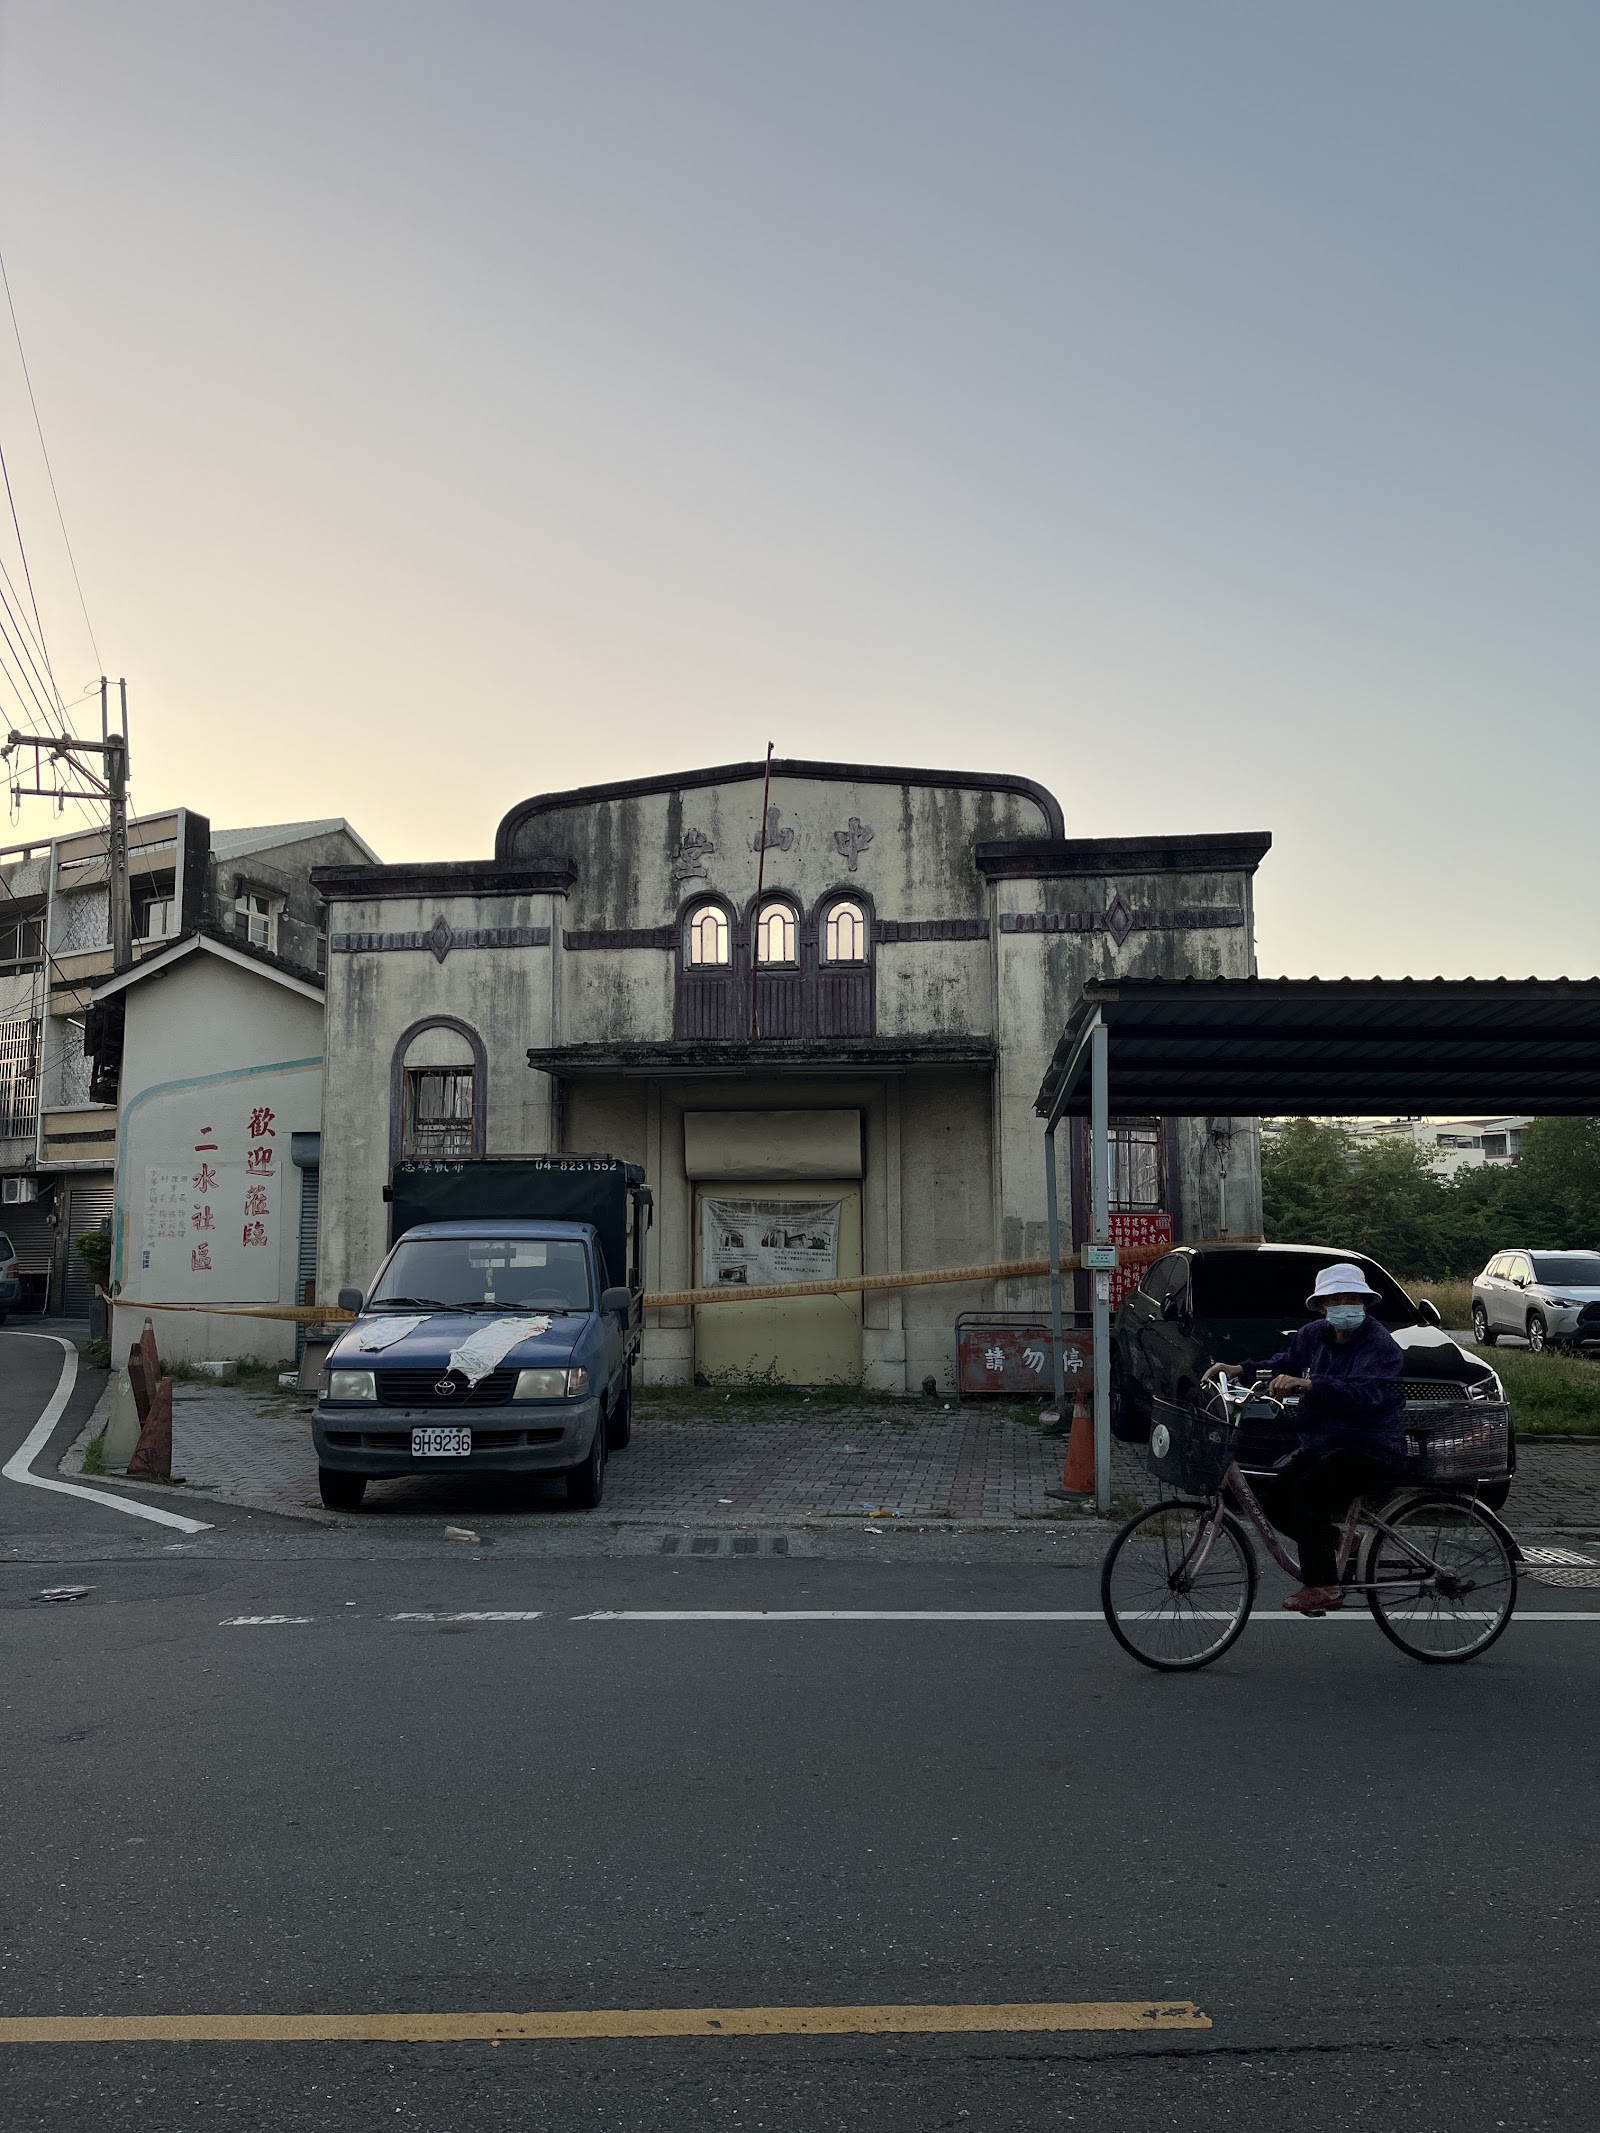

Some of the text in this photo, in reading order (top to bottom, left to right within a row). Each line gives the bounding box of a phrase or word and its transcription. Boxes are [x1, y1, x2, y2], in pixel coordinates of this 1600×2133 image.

[191, 1127, 219, 1271] 二水社區
[243, 1107, 276, 1247] 歡迎蒞臨
[535, 1160, 617, 1171] 04-8231552
[985, 1347, 1083, 1373] 請勿停
